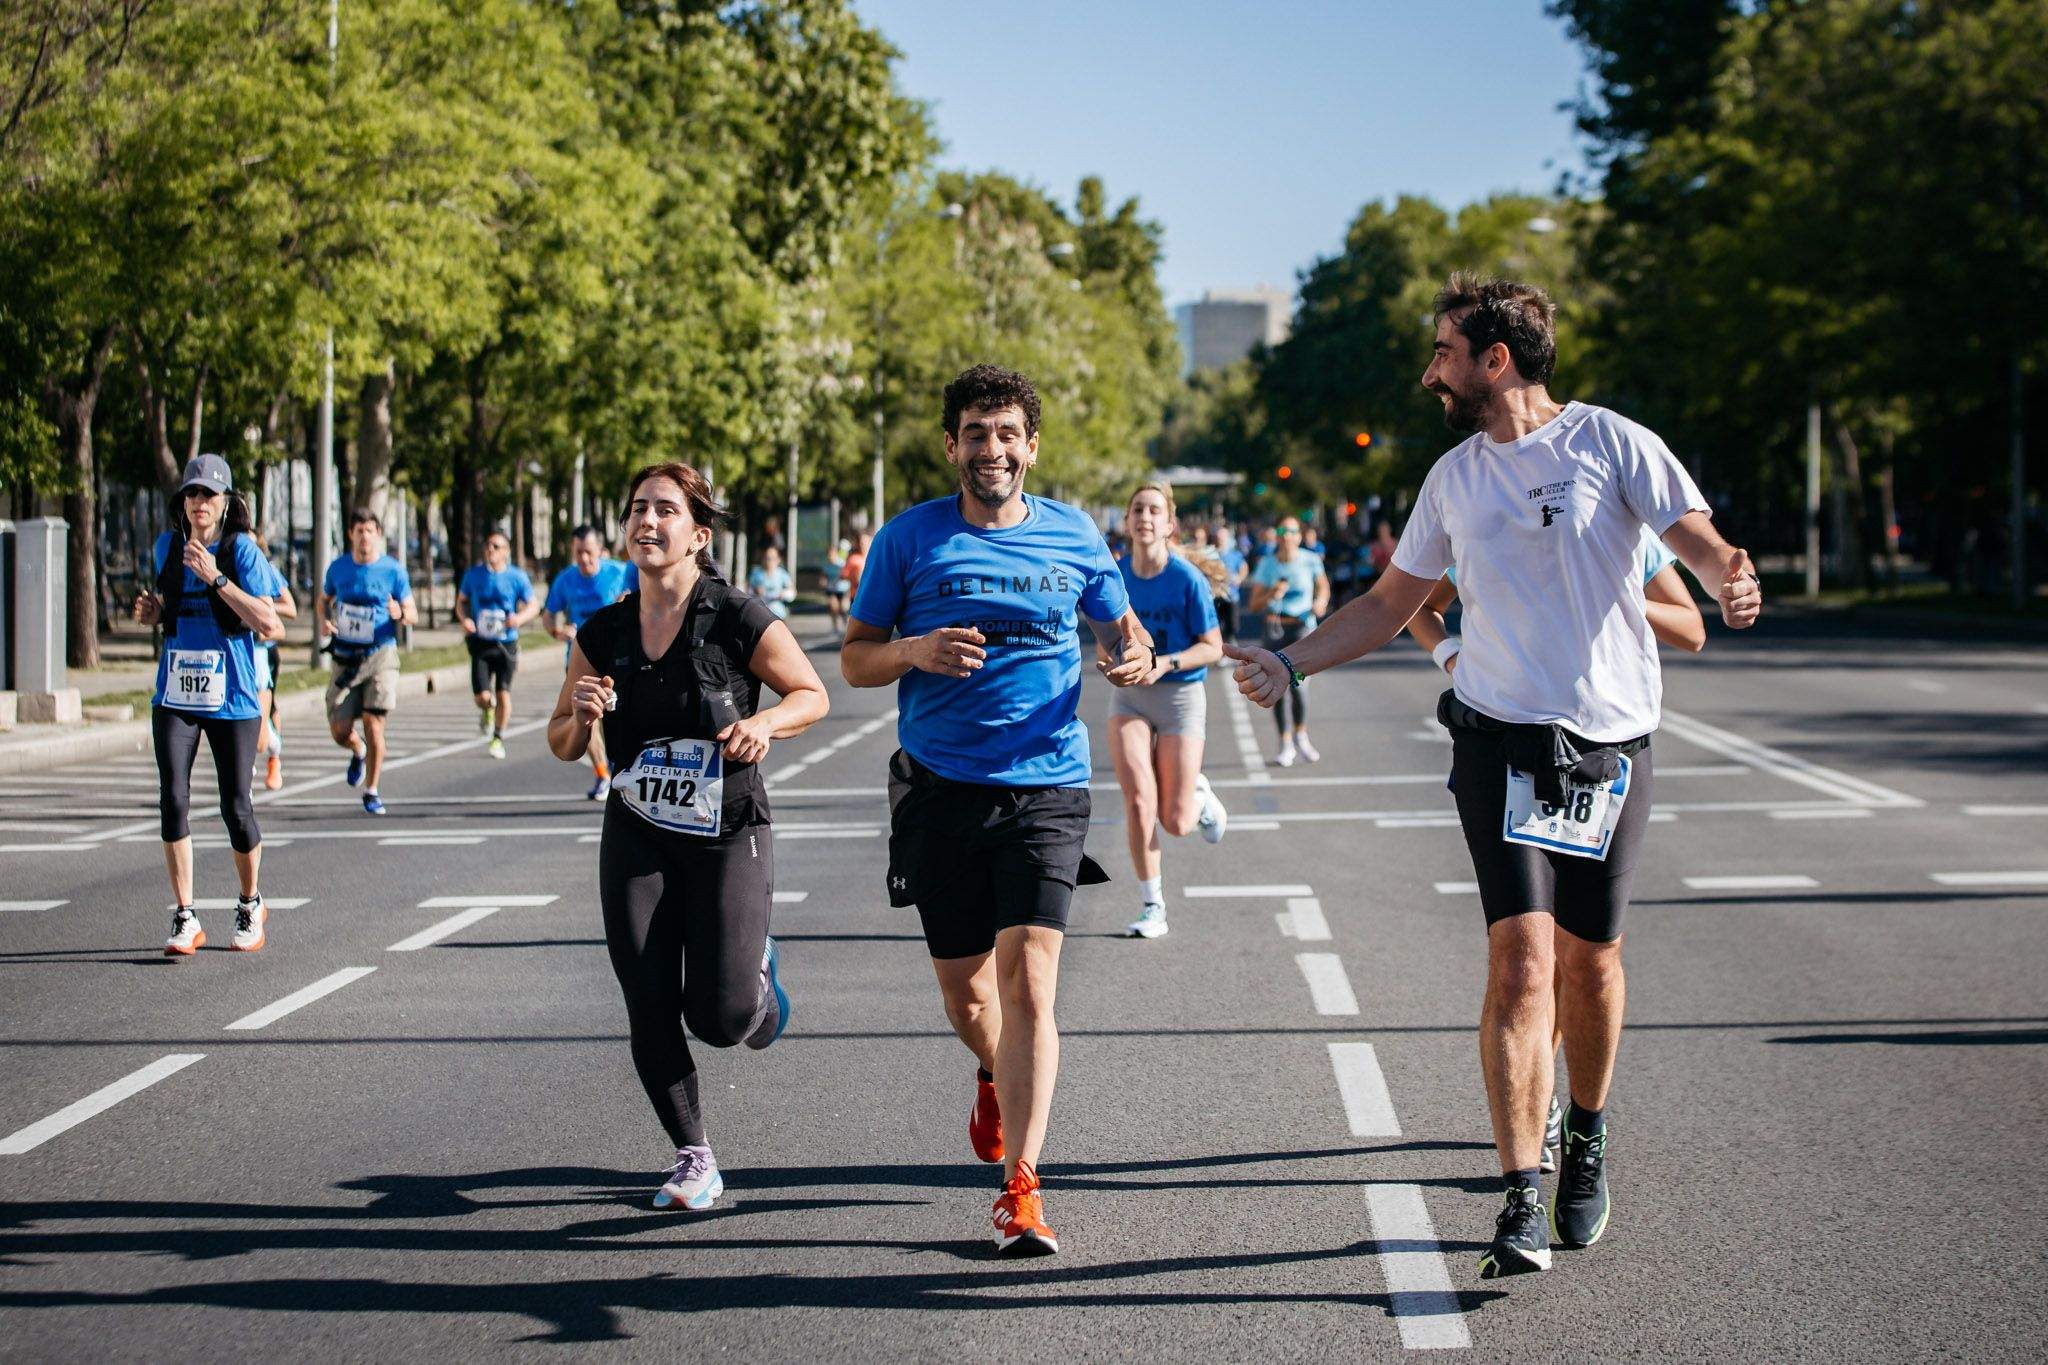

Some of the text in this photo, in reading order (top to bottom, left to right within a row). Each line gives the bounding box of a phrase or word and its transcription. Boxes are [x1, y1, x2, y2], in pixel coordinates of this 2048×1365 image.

[938, 576, 1068, 596] DECIMAS
[180, 675, 210, 693] 1912
[651, 749, 702, 762] BOBEROS
[643, 765, 700, 778] DECIMAS
[635, 776, 697, 808] 1742
